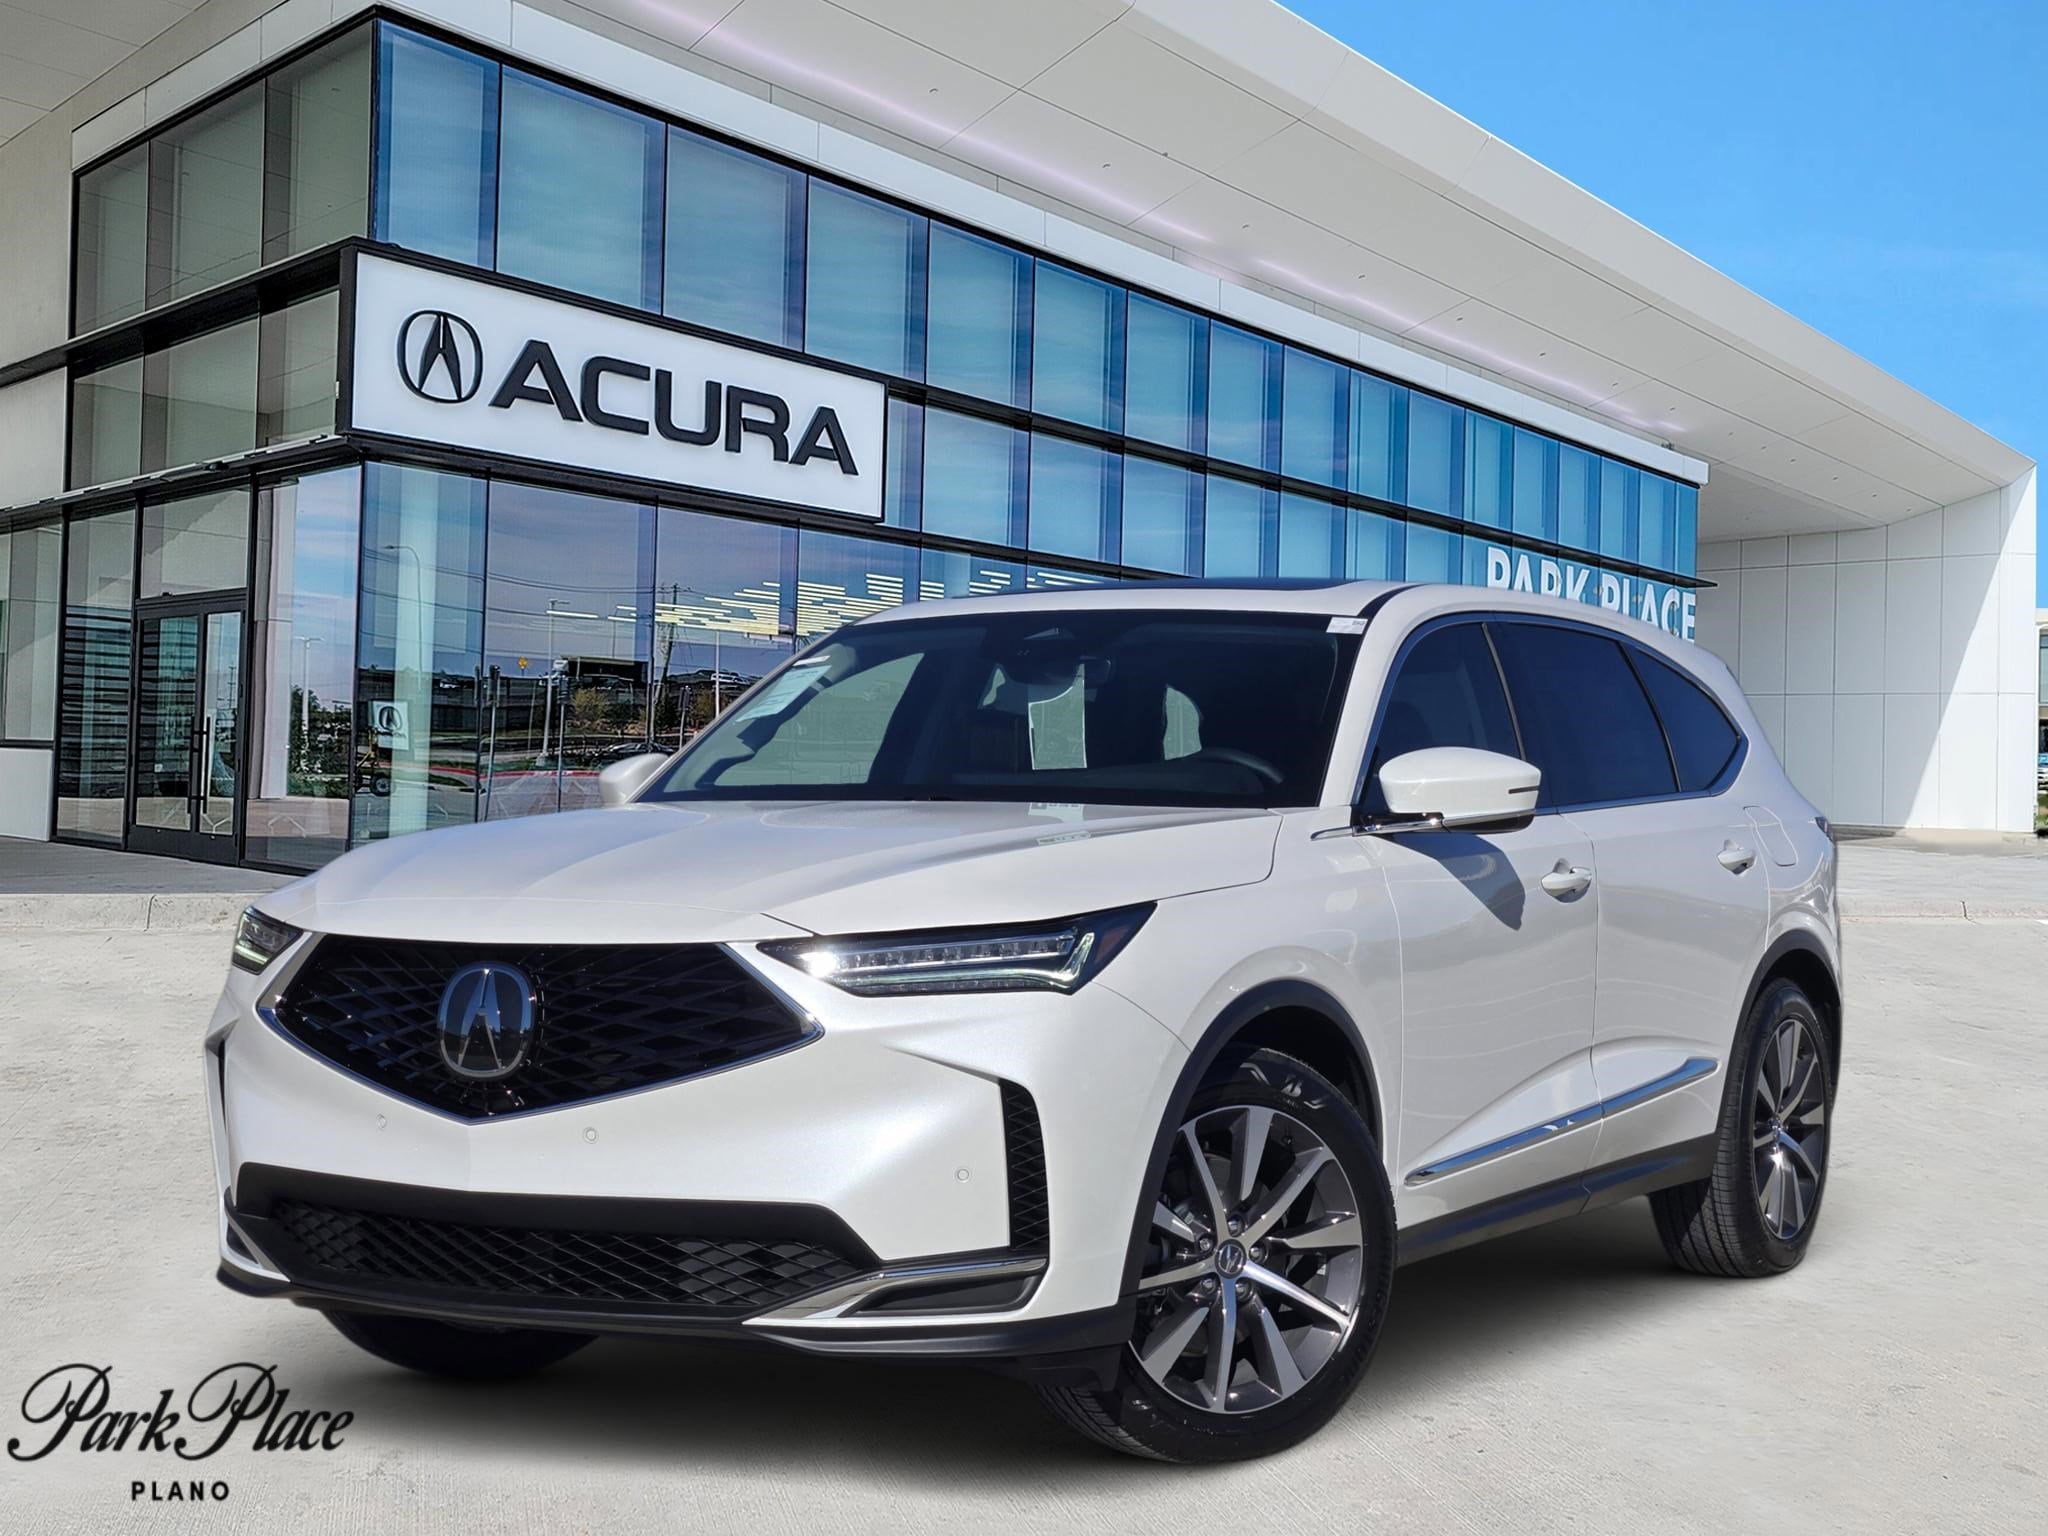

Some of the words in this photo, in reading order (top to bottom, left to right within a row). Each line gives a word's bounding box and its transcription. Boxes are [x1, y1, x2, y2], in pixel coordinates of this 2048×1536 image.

[488, 339, 860, 477] ACURA
[1487, 546, 1590, 603] PARK
[1601, 573, 1696, 643] PLACE
